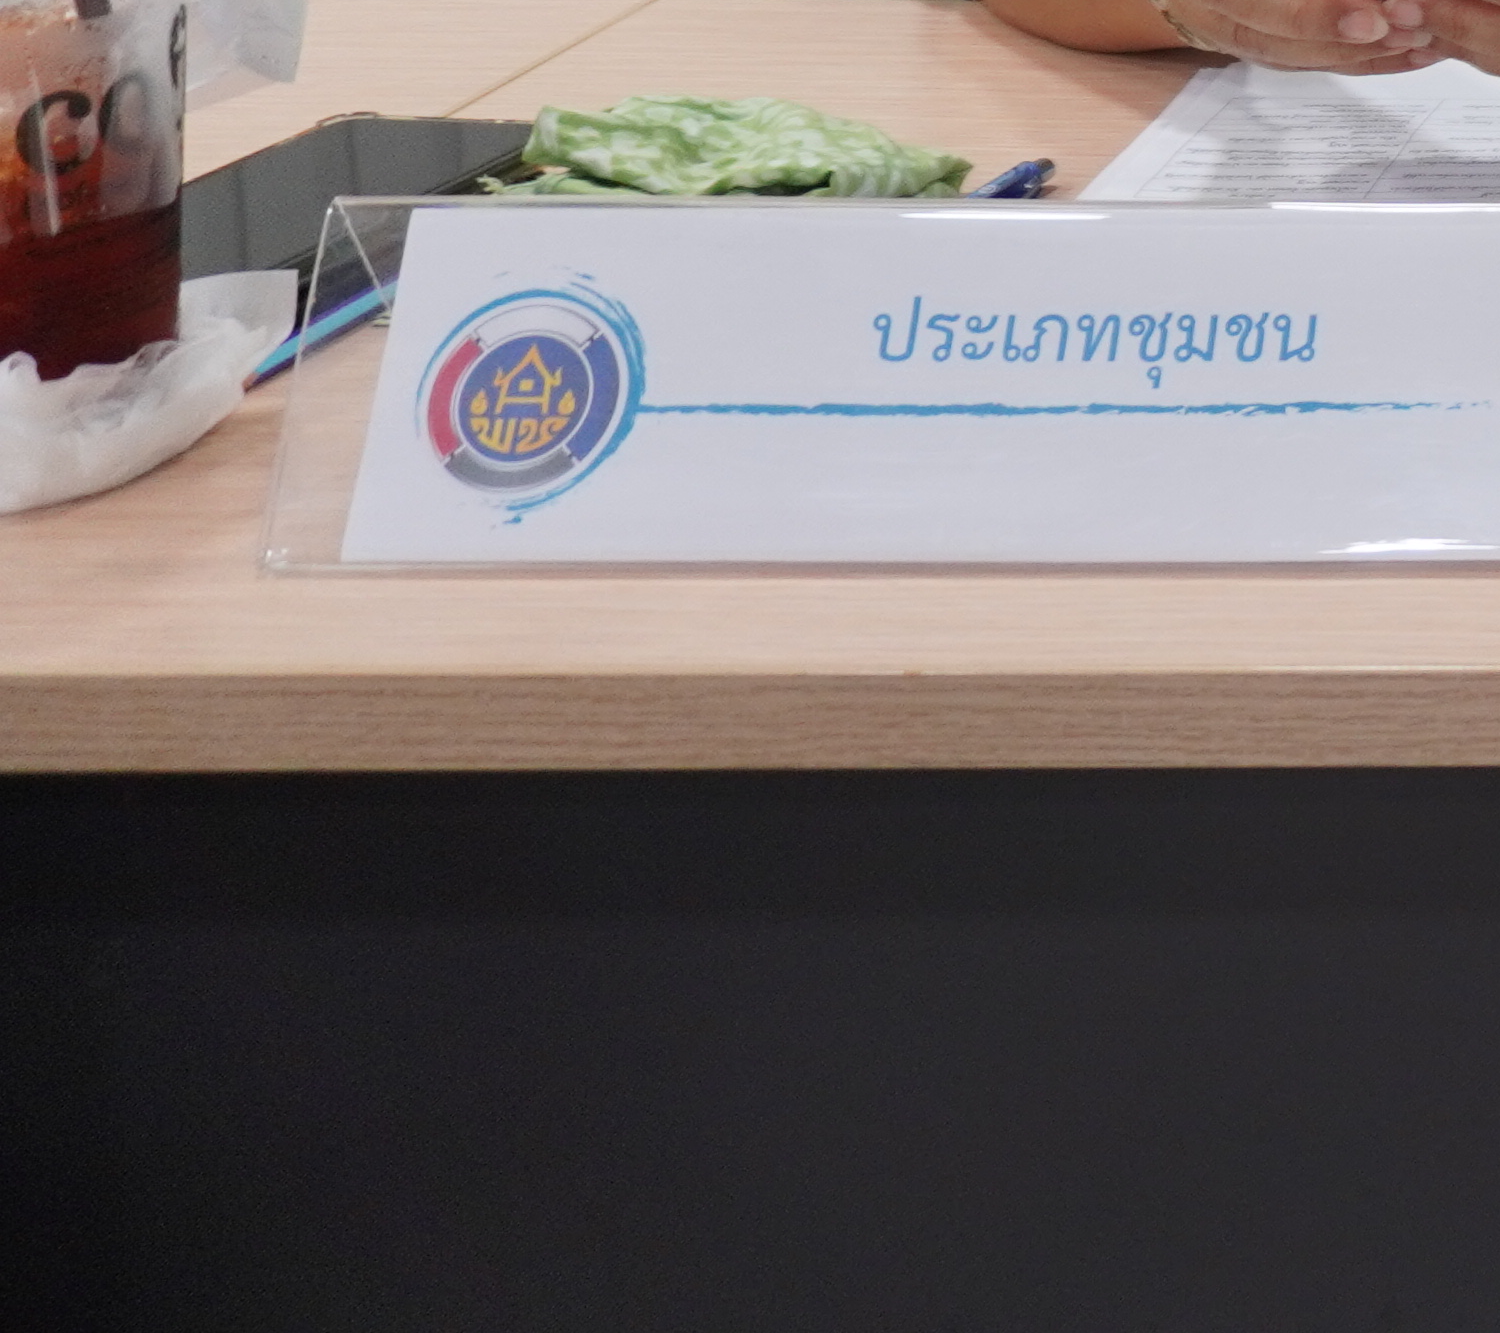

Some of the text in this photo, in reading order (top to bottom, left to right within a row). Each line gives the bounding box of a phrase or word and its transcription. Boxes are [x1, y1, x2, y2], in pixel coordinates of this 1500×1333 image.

[874, 293, 1318, 390] ประเภทชุมชน
